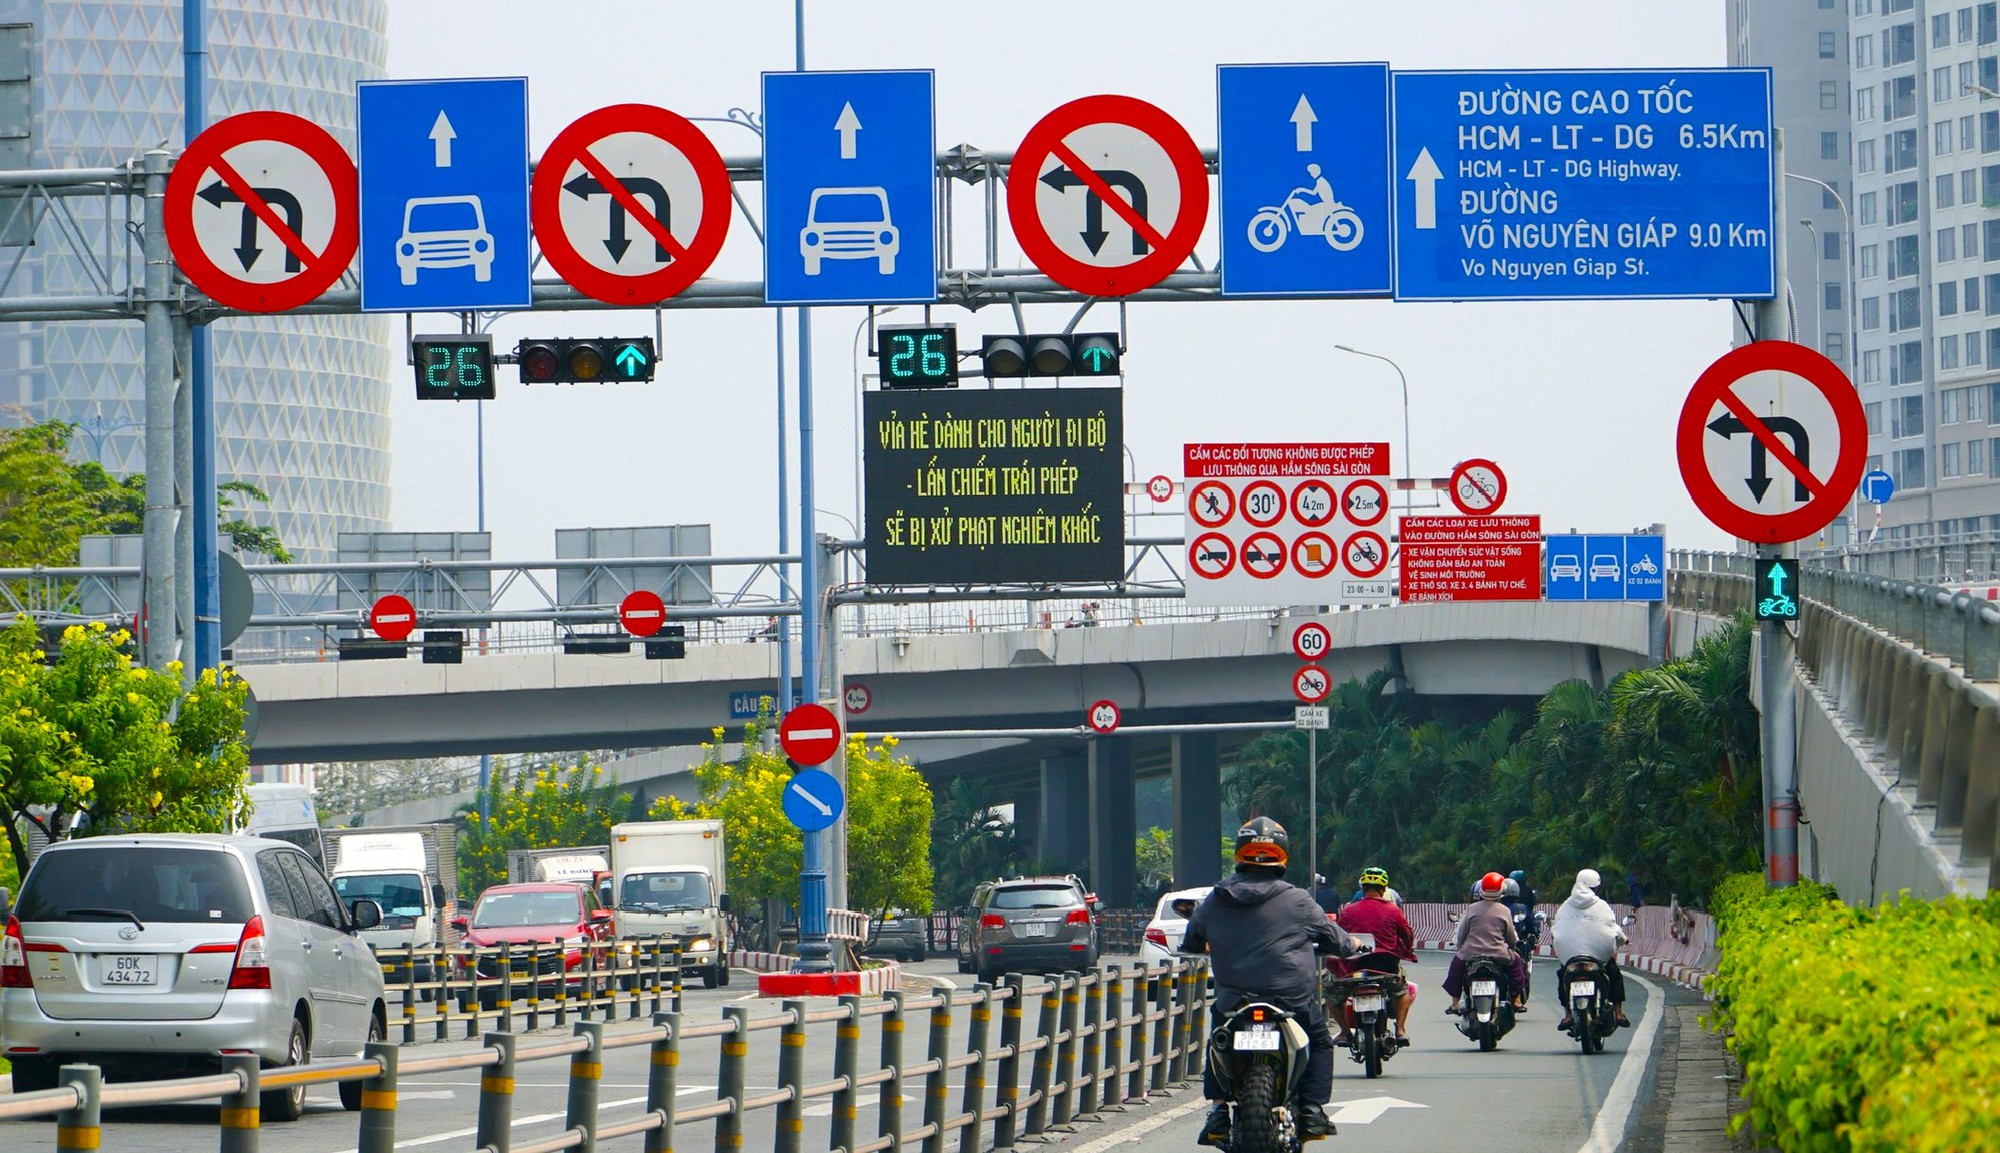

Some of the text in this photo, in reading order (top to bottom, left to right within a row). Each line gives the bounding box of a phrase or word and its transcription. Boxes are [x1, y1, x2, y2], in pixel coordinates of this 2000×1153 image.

[1458, 78, 1694, 116] ĐƯỜNG CAO TỐC
[1458, 125, 1520, 150] HCM
[1552, 125, 1583, 149] LT
[1615, 124, 1654, 149] DG
[1679, 123, 1765, 149] 6.5Km
[1459, 160, 1502, 178] HCM
[1523, 160, 1544, 177] LT
[1565, 160, 1591, 177] DG
[1599, 159, 1681, 181] Highway.
[1460, 182, 1558, 215] ĐƯỜNG
[1461, 216, 1766, 249] VÕ NGUYÊN GIÁP 9.0 Km
[1461, 258, 1649, 279] Vo Nguyen Giap St.
[892, 334, 946, 377] 26
[428, 347, 482, 387] 26
[879, 410, 1106, 452] VỈA HÈ DÀNH CHO NGƯỜI ĐI BỘ
[1190, 444, 1375, 461] CẤM CÁC ĐỐI TƯỢNG KHÔNG ĐƯỢC PHÉP
[917, 455, 946, 496] LẤN
[951, 454, 996, 495] CHIẾM
[1002, 459, 1036, 495] TRÁI
[1040, 458, 1078, 494] PHÉP
[1203, 460, 1371, 476] LƯU THÔNG QUA HẦM SÔNG SÀI GÒN
[1303, 495, 1324, 510] 4.2m
[1355, 496, 1374, 510] 2.5m
[886, 502, 1101, 551] SẼ BỊ XỬ PHẠT NGHIÊM KHẮC
[1427, 518, 1445, 528] CÁC
[1446, 519, 1465, 529] LOẠI
[1468, 519, 1478, 527] XE
[1481, 518, 1498, 527] LƯU
[1500, 517, 1530, 527] THÔNG
[1405, 530, 1422, 540] VÀO
[1424, 530, 1455, 540] ĐƯỜNG
[1479, 530, 1502, 540] SÔNG
[1504, 530, 1519, 539] SÀI
[1521, 529, 1539, 539] GÒN
[1408, 548, 1418, 556] XE
[1420, 547, 1435, 557] VẬN
[1469, 546, 1484, 556] SÚC
[1501, 545, 1522, 556] SỐNG
[1408, 558, 1434, 568] KHÔNG
[1472, 559, 1482, 567] AN
[1485, 558, 1505, 567] TOÀN
[1409, 570, 1418, 580] VỆ
[1439, 570, 1453, 578] MÔI
[1409, 582, 1418, 590] XE
[1420, 581, 1434, 590] THÔ
[1469, 581, 1474, 589] 4
[1476, 580, 1497, 589] BÁNH
[1498, 581, 1508, 590] TỰ
[1419, 592, 1437, 600] BÁNH
[1302, 633, 1322, 650] 60
[117, 957, 139, 970] 60K
[107, 971, 150, 982] 434.72
